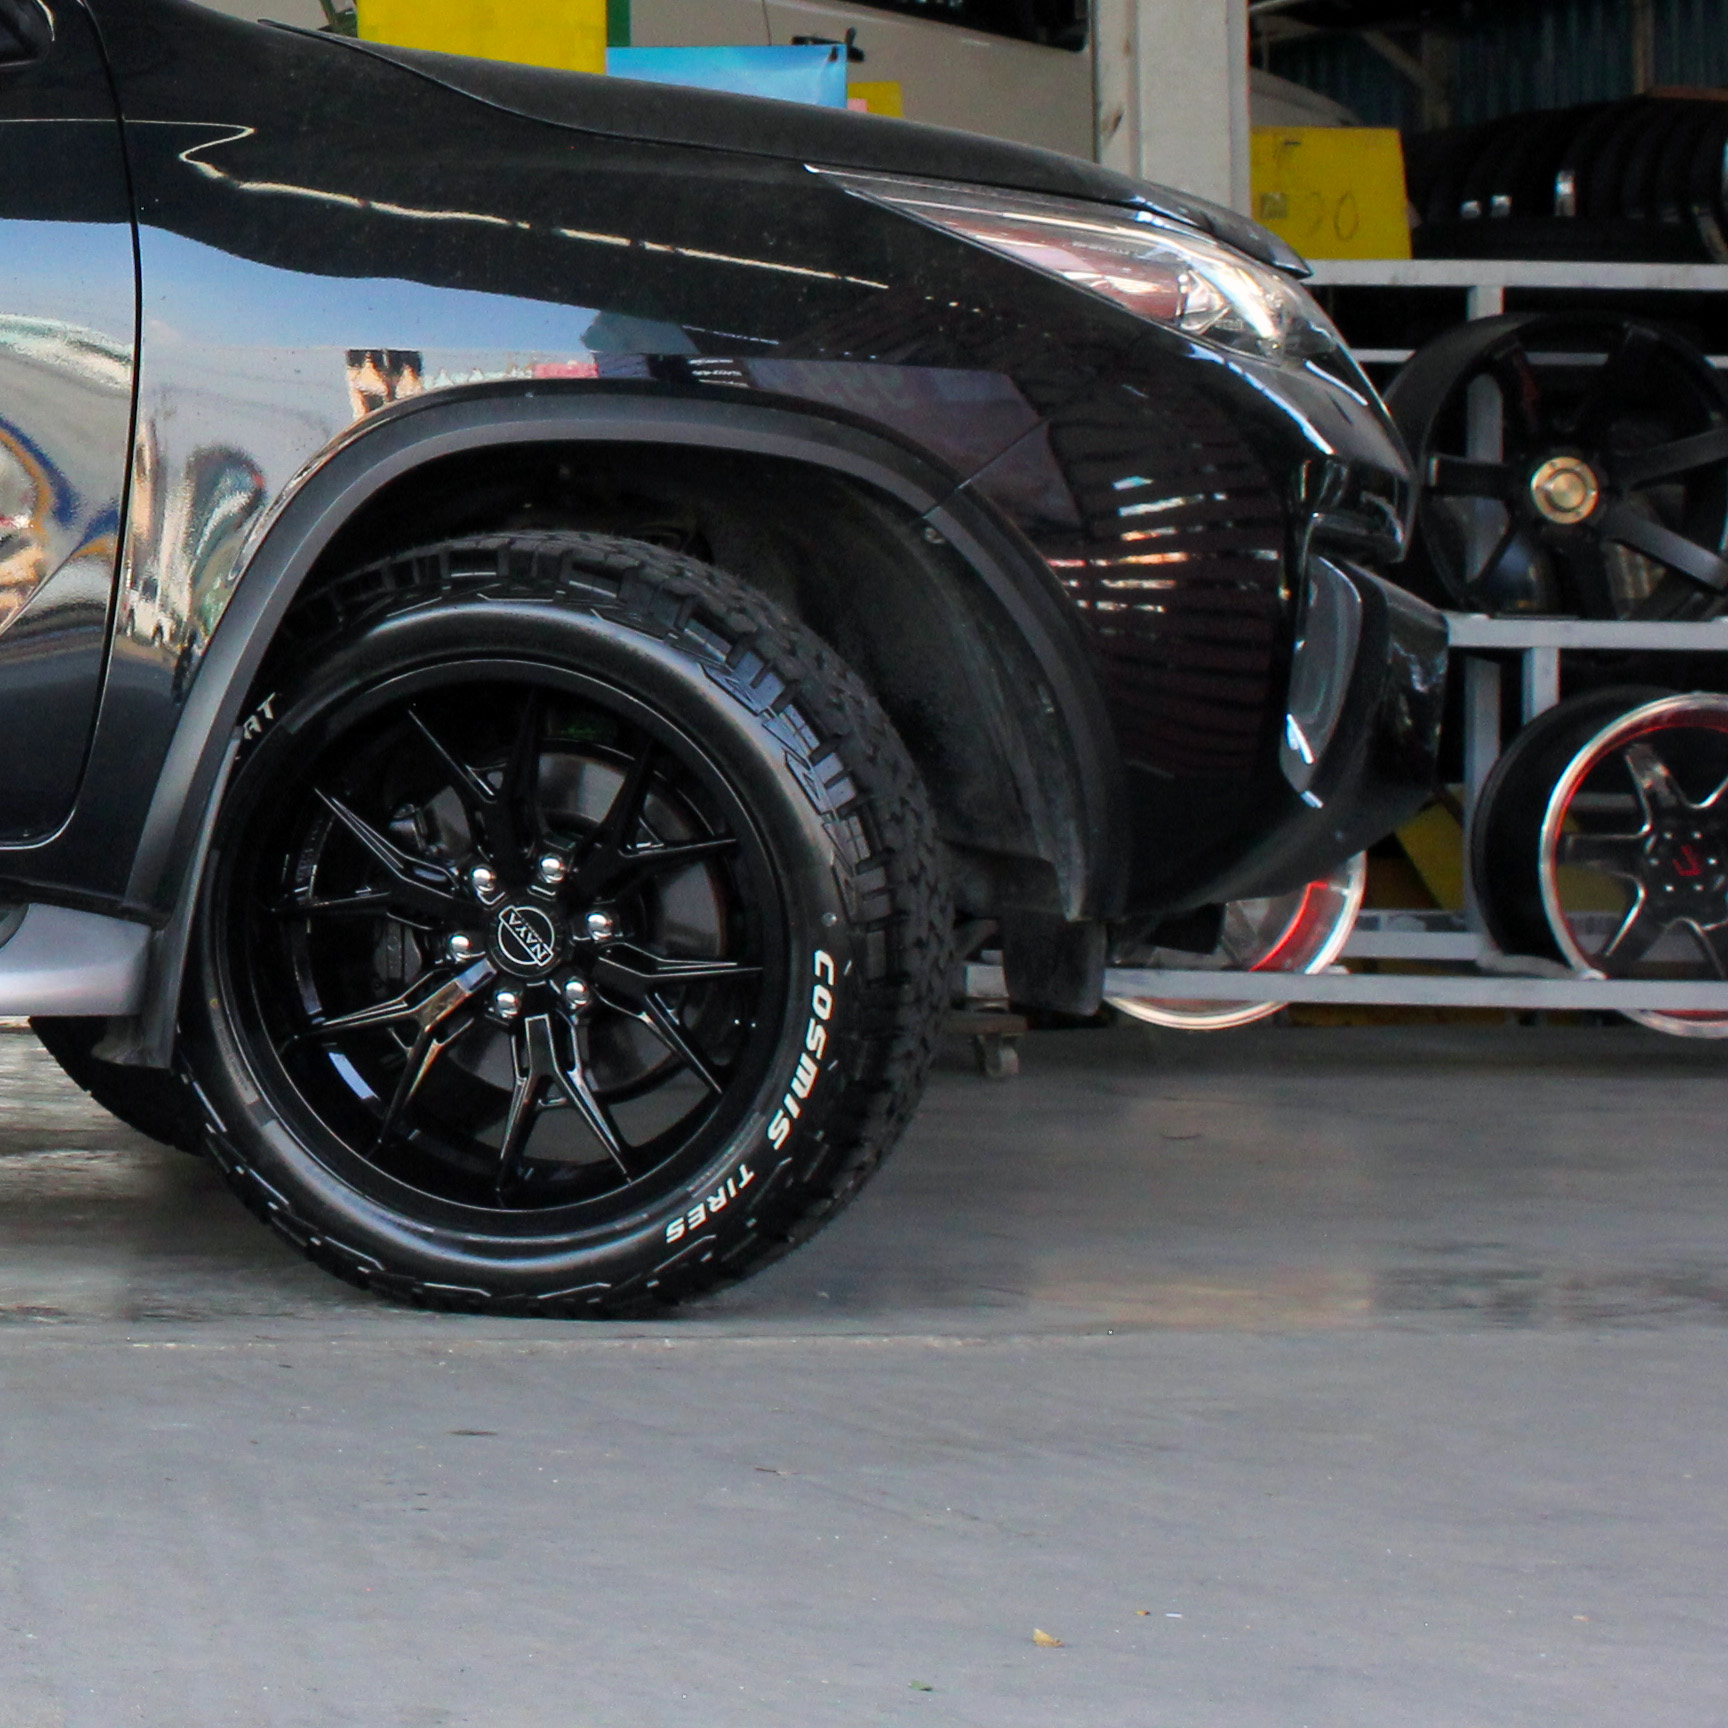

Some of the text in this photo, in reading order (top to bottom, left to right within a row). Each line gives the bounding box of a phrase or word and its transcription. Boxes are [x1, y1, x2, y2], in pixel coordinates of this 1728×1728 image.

[509, 912, 549, 960] NAYA
[766, 949, 836, 1151] COSMIS
[664, 1163, 757, 1245] TIRES
